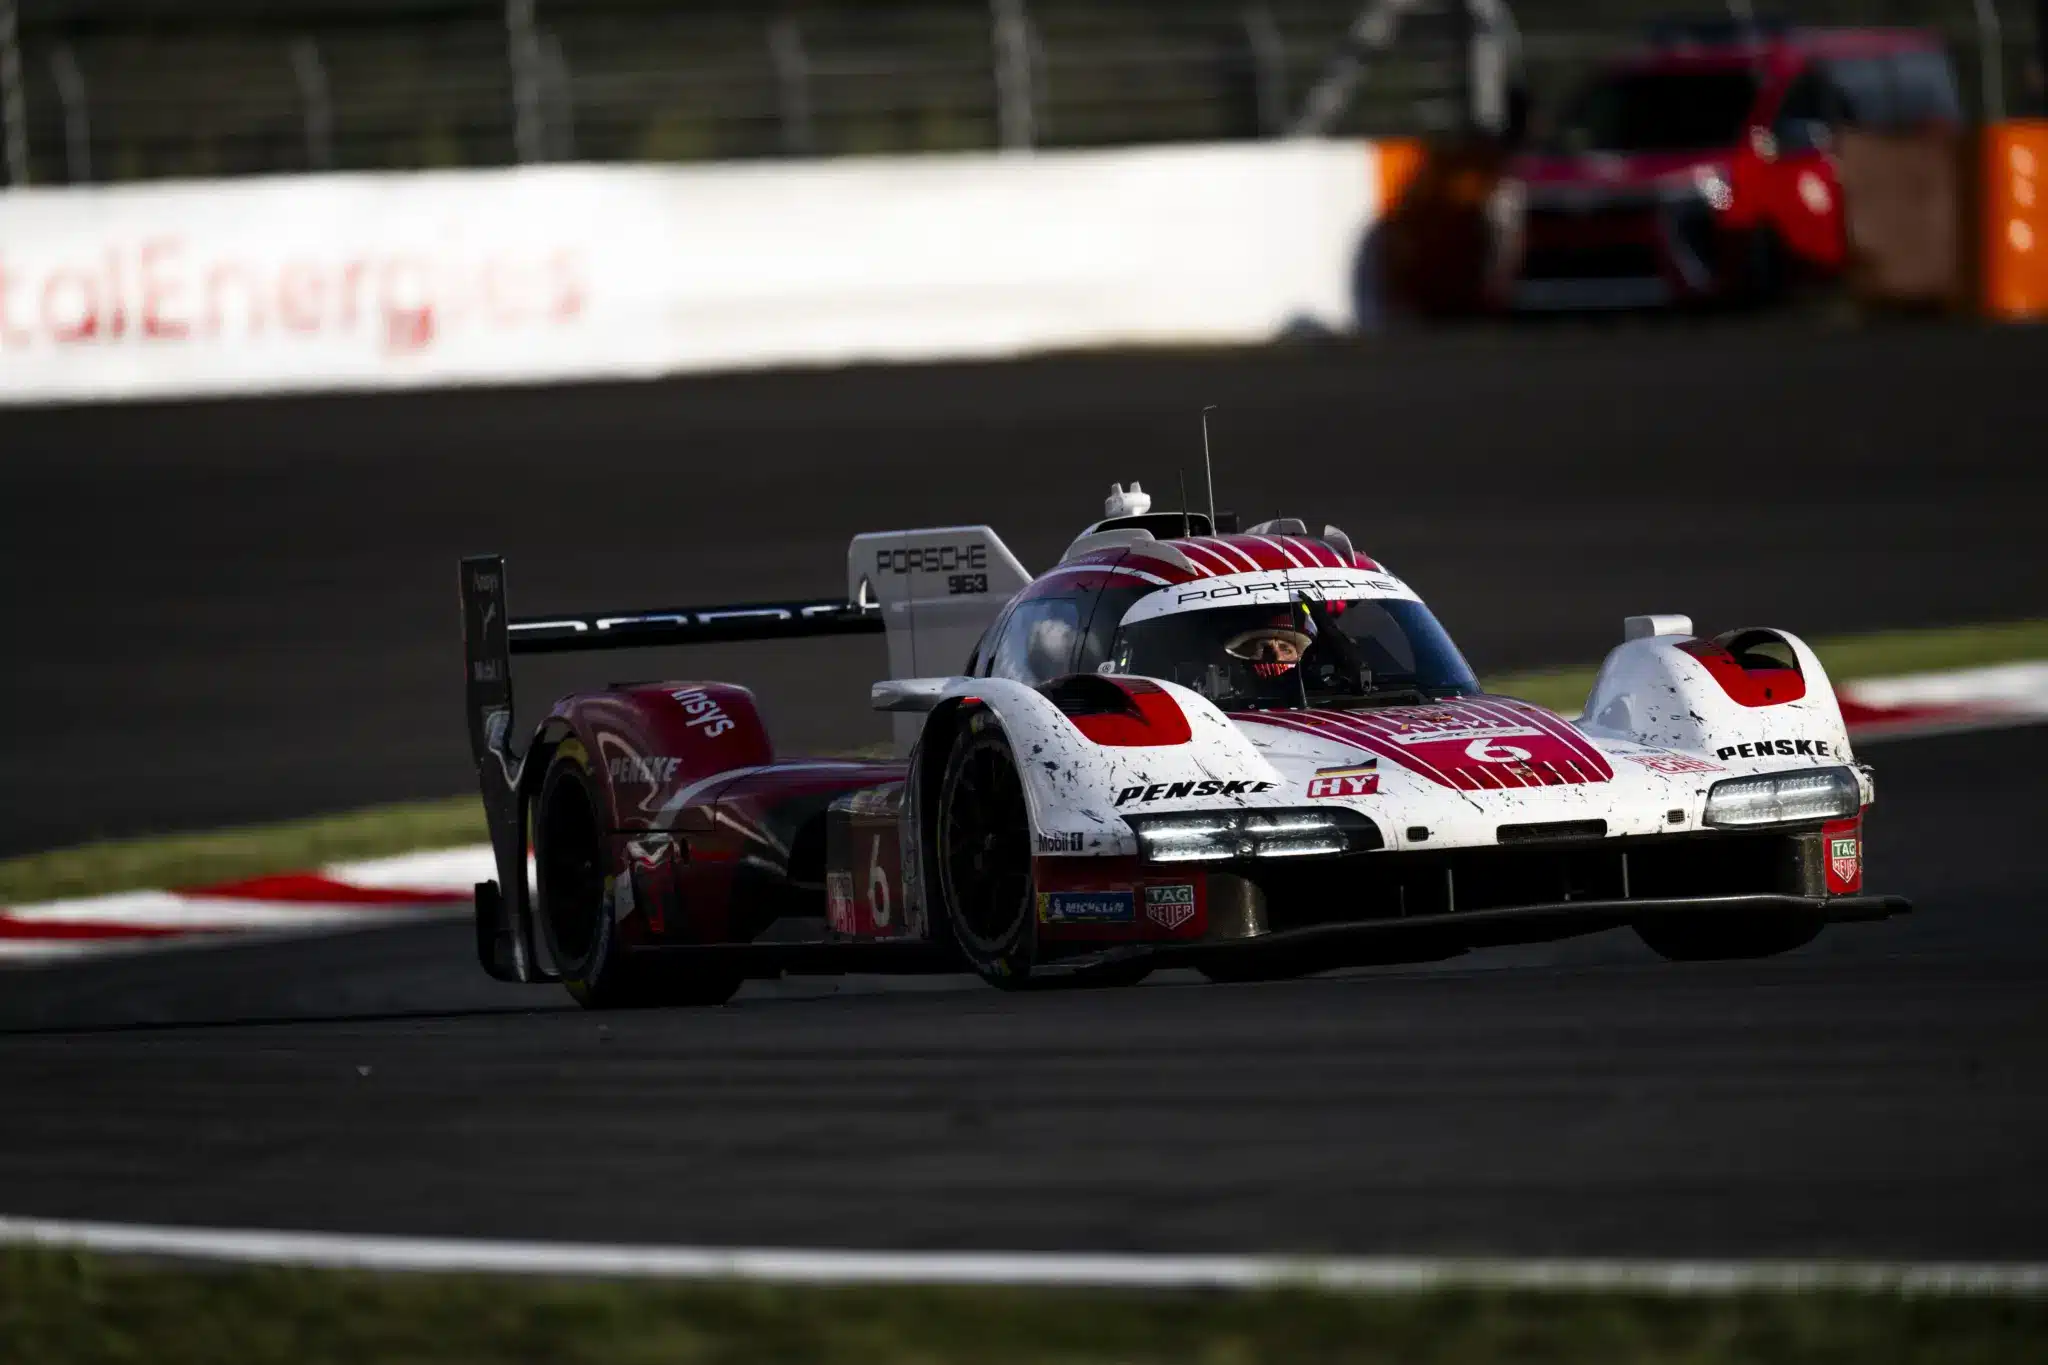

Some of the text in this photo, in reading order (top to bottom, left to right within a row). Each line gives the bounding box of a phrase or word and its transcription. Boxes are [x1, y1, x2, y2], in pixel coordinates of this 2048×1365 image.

[876, 544, 987, 576] PORSCHE
[948, 573, 989, 595] 963
[1177, 579, 1400, 605] PORSCHE
[1464, 739, 1533, 763] 6
[1714, 739, 1830, 761] PENSKE
[1113, 779, 1282, 808] PENSKE
[1312, 775, 1376, 797] HY
[1038, 831, 1084, 853] Mobil 1
[1834, 842, 1856, 856] TAG
[1833, 858, 1857, 880] HEUER
[866, 834, 892, 929] 6
[1150, 888, 1190, 902] TAG
[1065, 901, 1125, 914] MICHELIN
[1148, 903, 1193, 927] HEUER
